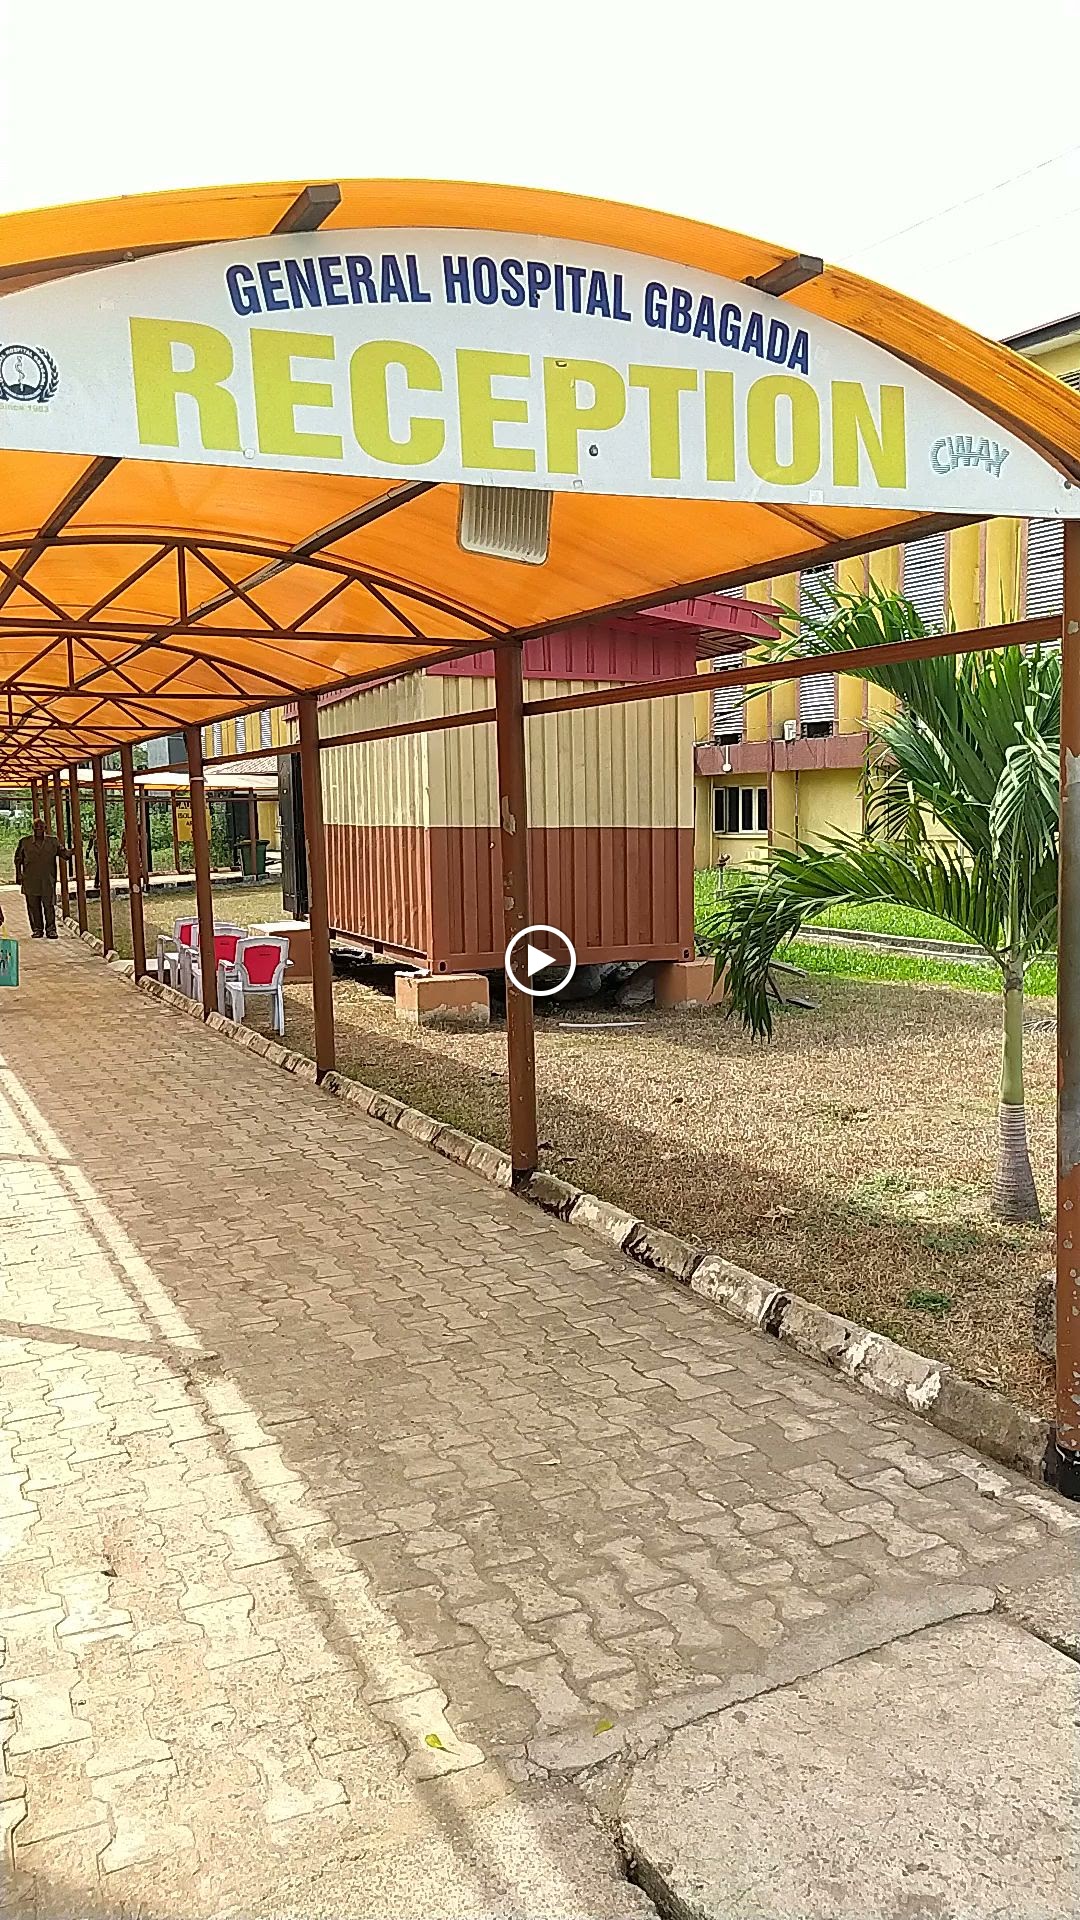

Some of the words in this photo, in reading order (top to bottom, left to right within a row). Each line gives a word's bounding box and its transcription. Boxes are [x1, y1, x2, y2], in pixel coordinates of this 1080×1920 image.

[226, 254, 432, 316] GENERAL
[443, 255, 632, 322] HOSPITAL
[643, 281, 810, 376] GBAGADA
[128, 316, 908, 490] RECEPTION
